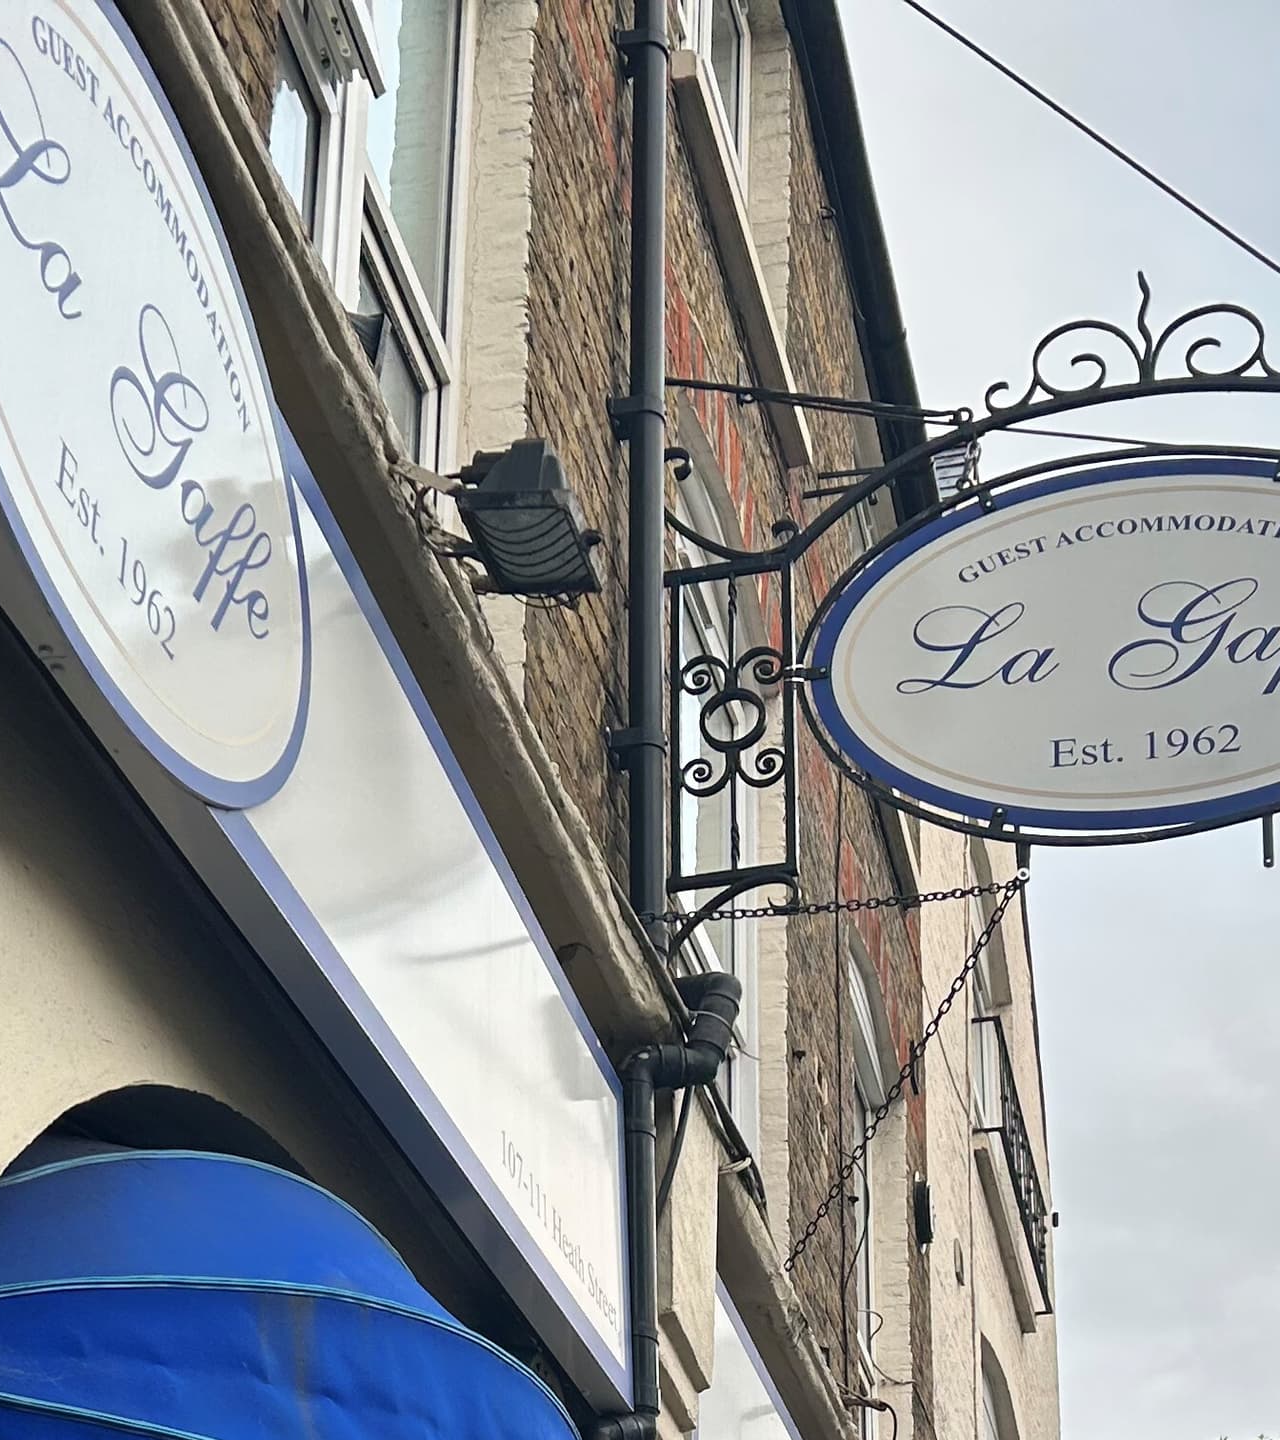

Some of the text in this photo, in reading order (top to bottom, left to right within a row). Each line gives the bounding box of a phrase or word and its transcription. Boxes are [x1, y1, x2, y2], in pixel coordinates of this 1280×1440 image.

[30, 14, 251, 433] GUEST ACCOMMODATION
[54, 437, 178, 660] Est. 1962
[110, 303, 272, 640] Gaffe
[957, 536, 1048, 585] GUEST
[895, 601, 1060, 695] La
[1049, 722, 1242, 770] Est. 1962
[500, 1129, 548, 1230] 107-111
[551, 1206, 586, 1285] Heath
